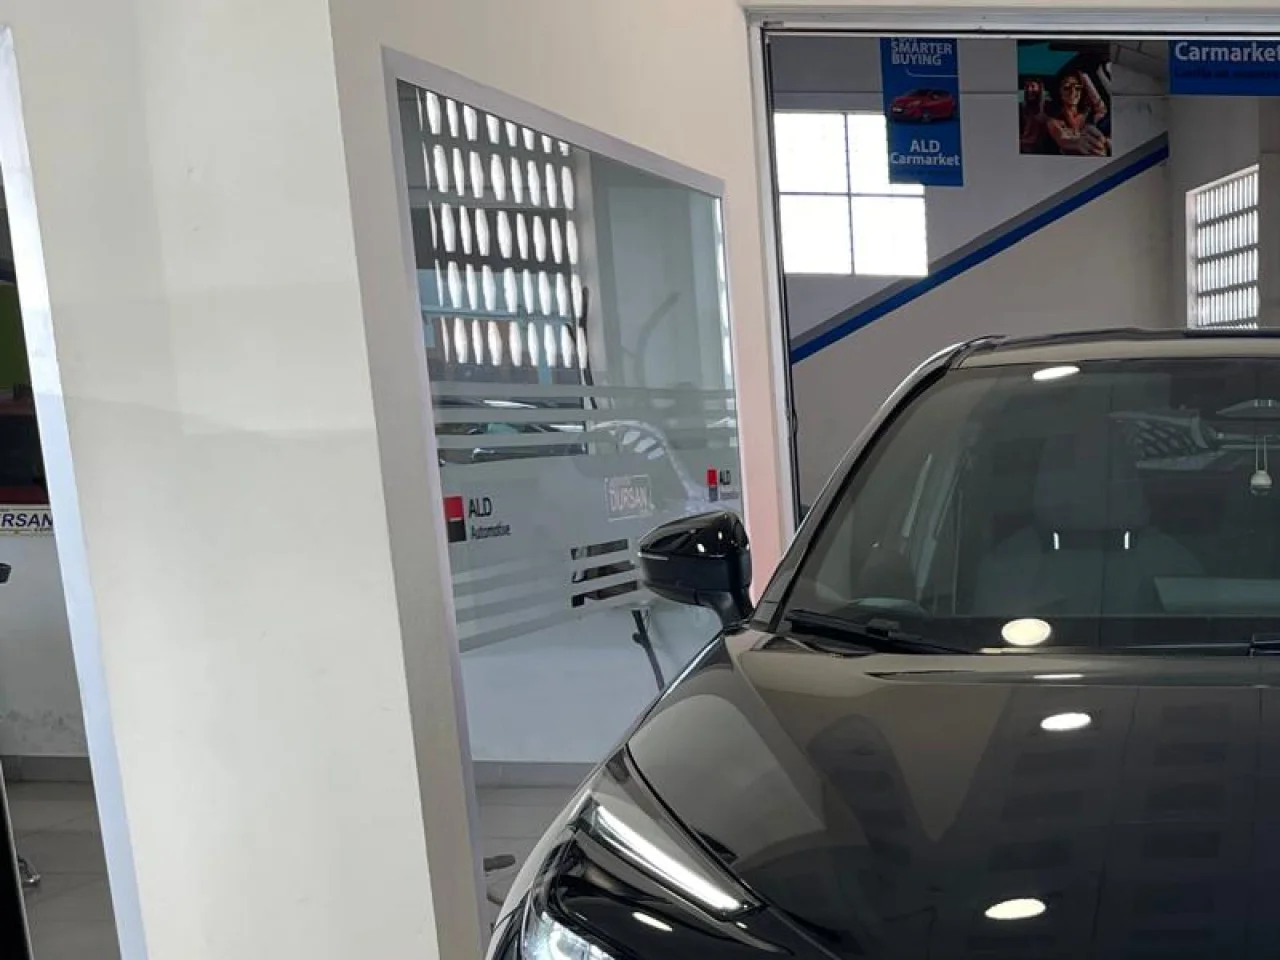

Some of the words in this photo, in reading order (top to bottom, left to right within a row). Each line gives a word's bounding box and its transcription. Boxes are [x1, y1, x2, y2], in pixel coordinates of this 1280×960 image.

[891, 41, 952, 55] SMARTER
[892, 53, 942, 65] BUYING
[909, 139, 940, 153] ALD
[890, 152, 960, 165] Carmarket
[469, 497, 492, 518] ALD
